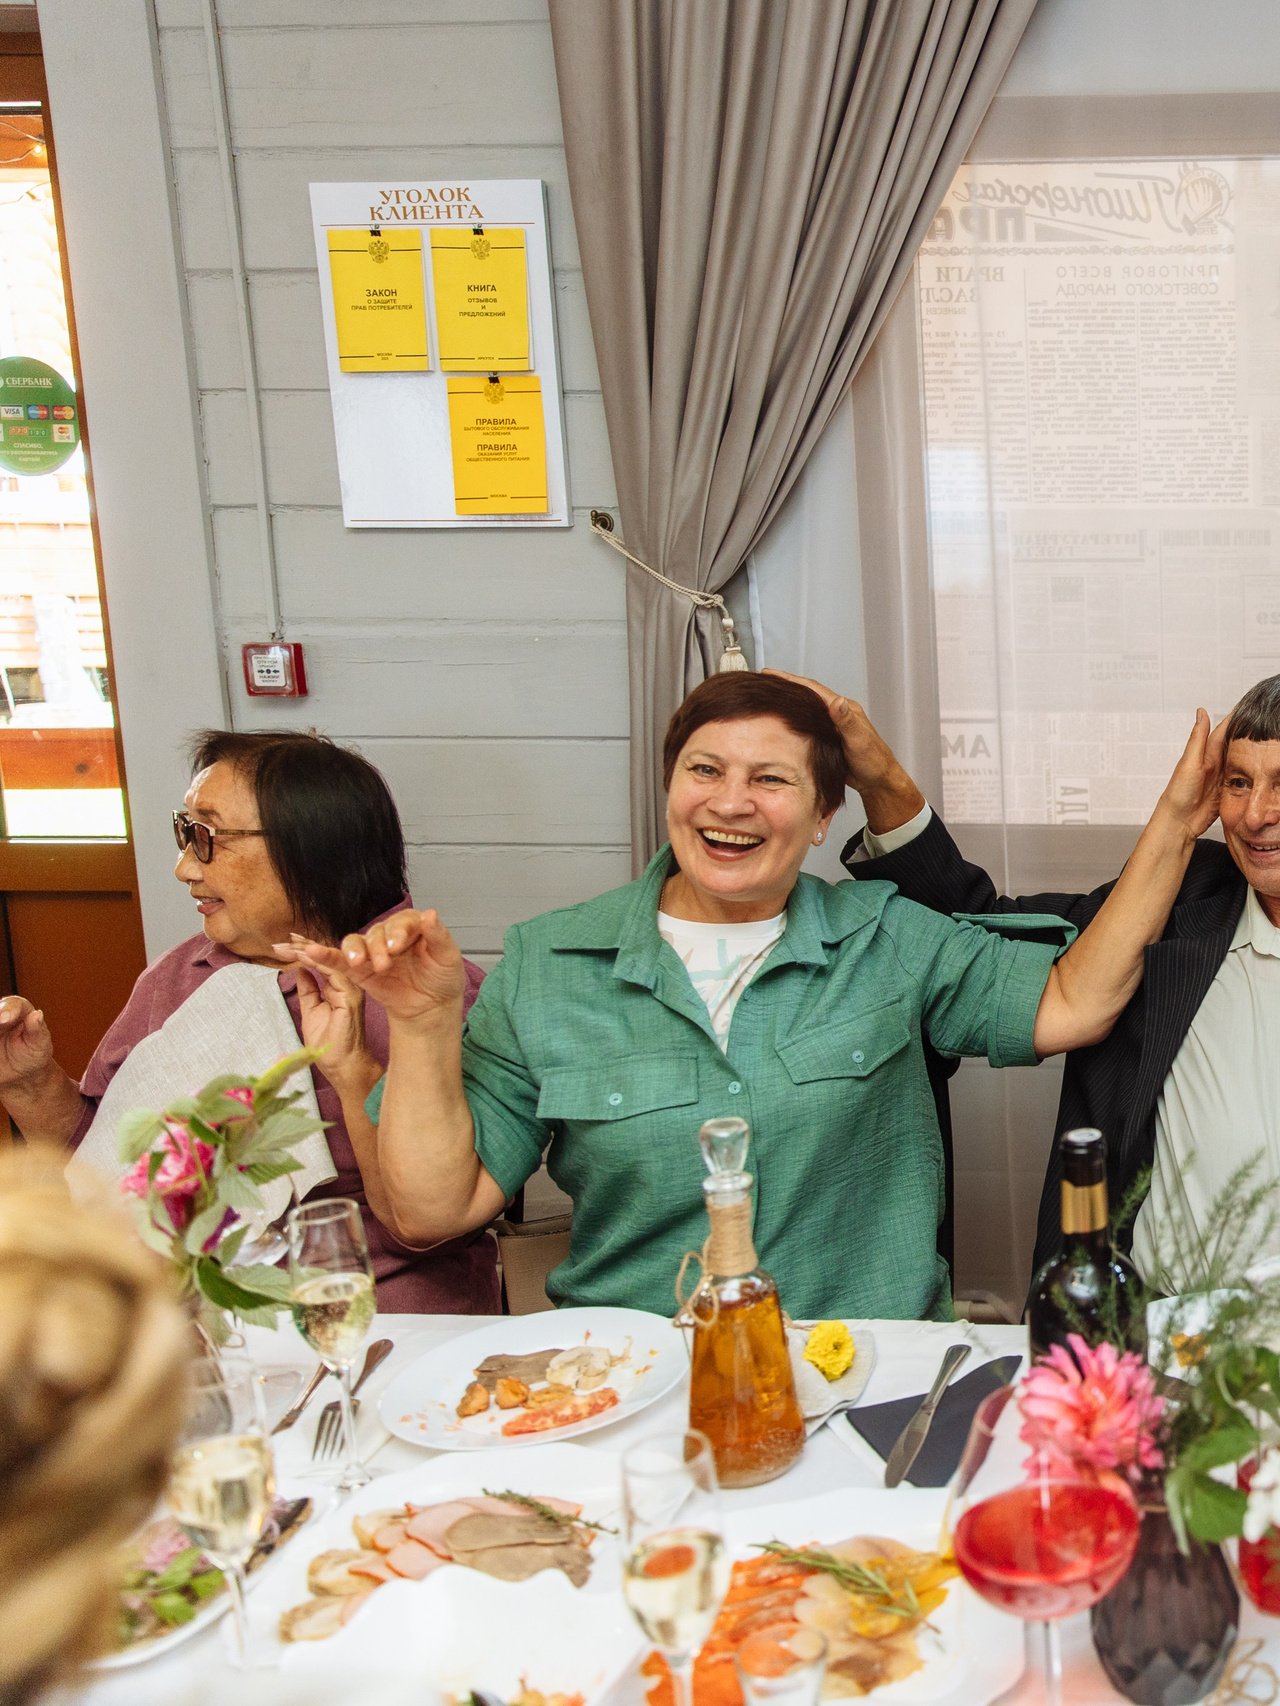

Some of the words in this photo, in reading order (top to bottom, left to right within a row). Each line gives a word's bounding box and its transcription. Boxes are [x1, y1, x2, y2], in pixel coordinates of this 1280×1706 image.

[379, 187, 471, 205] УГОЛОК
[369, 204, 484, 221] КЛИЕНТА
[467, 284, 497, 292] КНИГА
[365, 289, 398, 297] ЗАКОН
[5, 377, 53, 387] СБЕРБАНК
[4, 407, 20, 415] VISA
[475, 418, 517, 426] ПРАВИЛА
